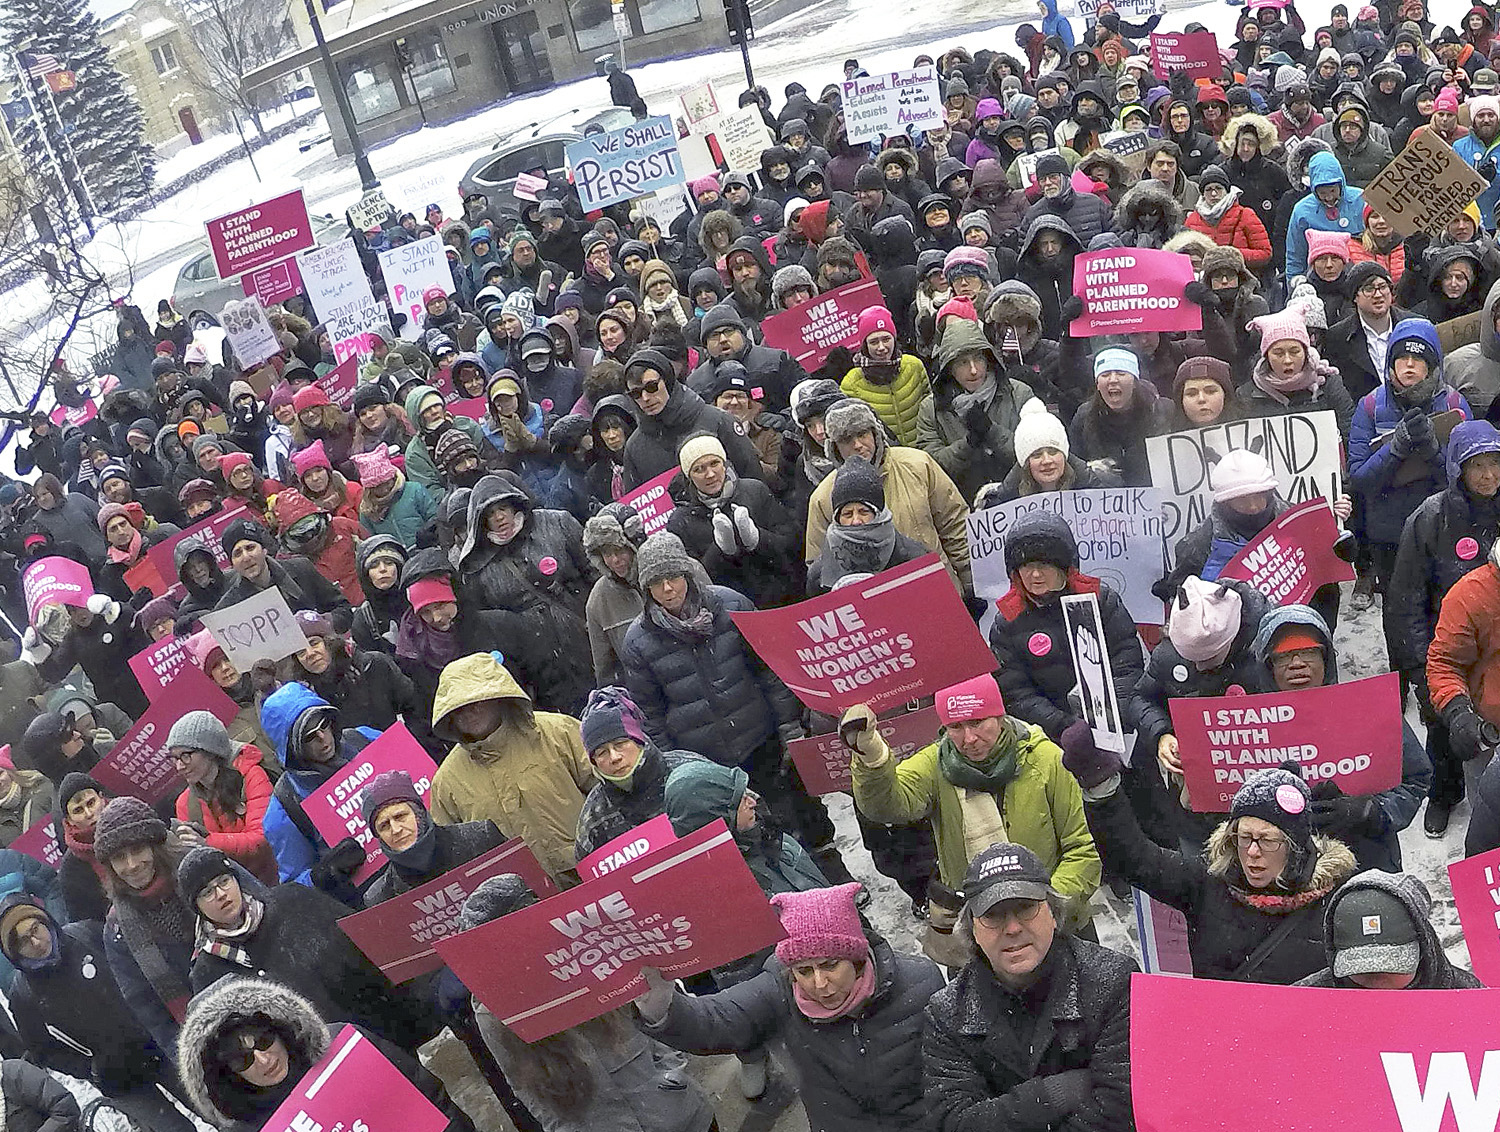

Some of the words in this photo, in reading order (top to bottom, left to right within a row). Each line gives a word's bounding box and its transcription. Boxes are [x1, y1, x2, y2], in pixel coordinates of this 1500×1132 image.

[479, 2, 517, 23] UNION
[591, 134, 620, 154] WE
[624, 126, 672, 149] SHALL
[575, 147, 678, 204] PERSIST
[1371, 141, 1432, 194] TRANS
[1386, 151, 1450, 213] UTEROUS
[1413, 181, 1464, 227] PLANNED
[1418, 183, 1442, 205] FOR
[226, 210, 261, 228] STAND
[1424, 181, 1481, 238] PARENTHOOD
[223, 224, 251, 240] WITH
[225, 227, 274, 250] PLANNED
[228, 228, 298, 261] PARENTHOOD
[403, 241, 440, 262] STAND
[1092, 256, 1136, 271] STAND
[402, 258, 435, 275] WITH
[1086, 271, 1119, 286] WITH
[1086, 284, 1148, 300] PLANNED
[1088, 298, 1179, 314] PARENTHOOD
[337, 314, 354, 330] ARE
[361, 304, 381, 319] YOU
[801, 313, 838, 334] MARCH
[806, 299, 838, 321] WE
[334, 322, 362, 341] DOWN
[802, 314, 858, 344] WOMEN'S
[818, 325, 858, 349] RIGHTS
[968, 511, 1008, 540] We
[1073, 492, 1092, 514] to
[1101, 489, 1147, 515] talk
[1143, 514, 1160, 537] in
[1241, 534, 1281, 573] WE
[253, 608, 282, 642] PP
[797, 604, 866, 643] WE
[796, 631, 868, 662] MARCH
[868, 627, 888, 640] FOR
[800, 633, 913, 679] WOMEN'S
[831, 653, 916, 694] RIGHTS
[1203, 711, 1212, 726] I
[1217, 705, 1295, 727] STAND
[117, 722, 156, 764] STAND
[1207, 728, 1270, 746] WITH
[120, 744, 154, 776] WITH
[1211, 744, 1318, 765] PLANNED
[336, 762, 375, 800] STAND
[605, 837, 652, 876] STAND
[1484, 866, 1494, 885] I
[549, 890, 636, 939] WE
[545, 920, 638, 966] MARCH
[638, 913, 663, 927] FOR
[549, 915, 691, 981] WOMEN'S
[591, 934, 693, 981] RIGHTS
